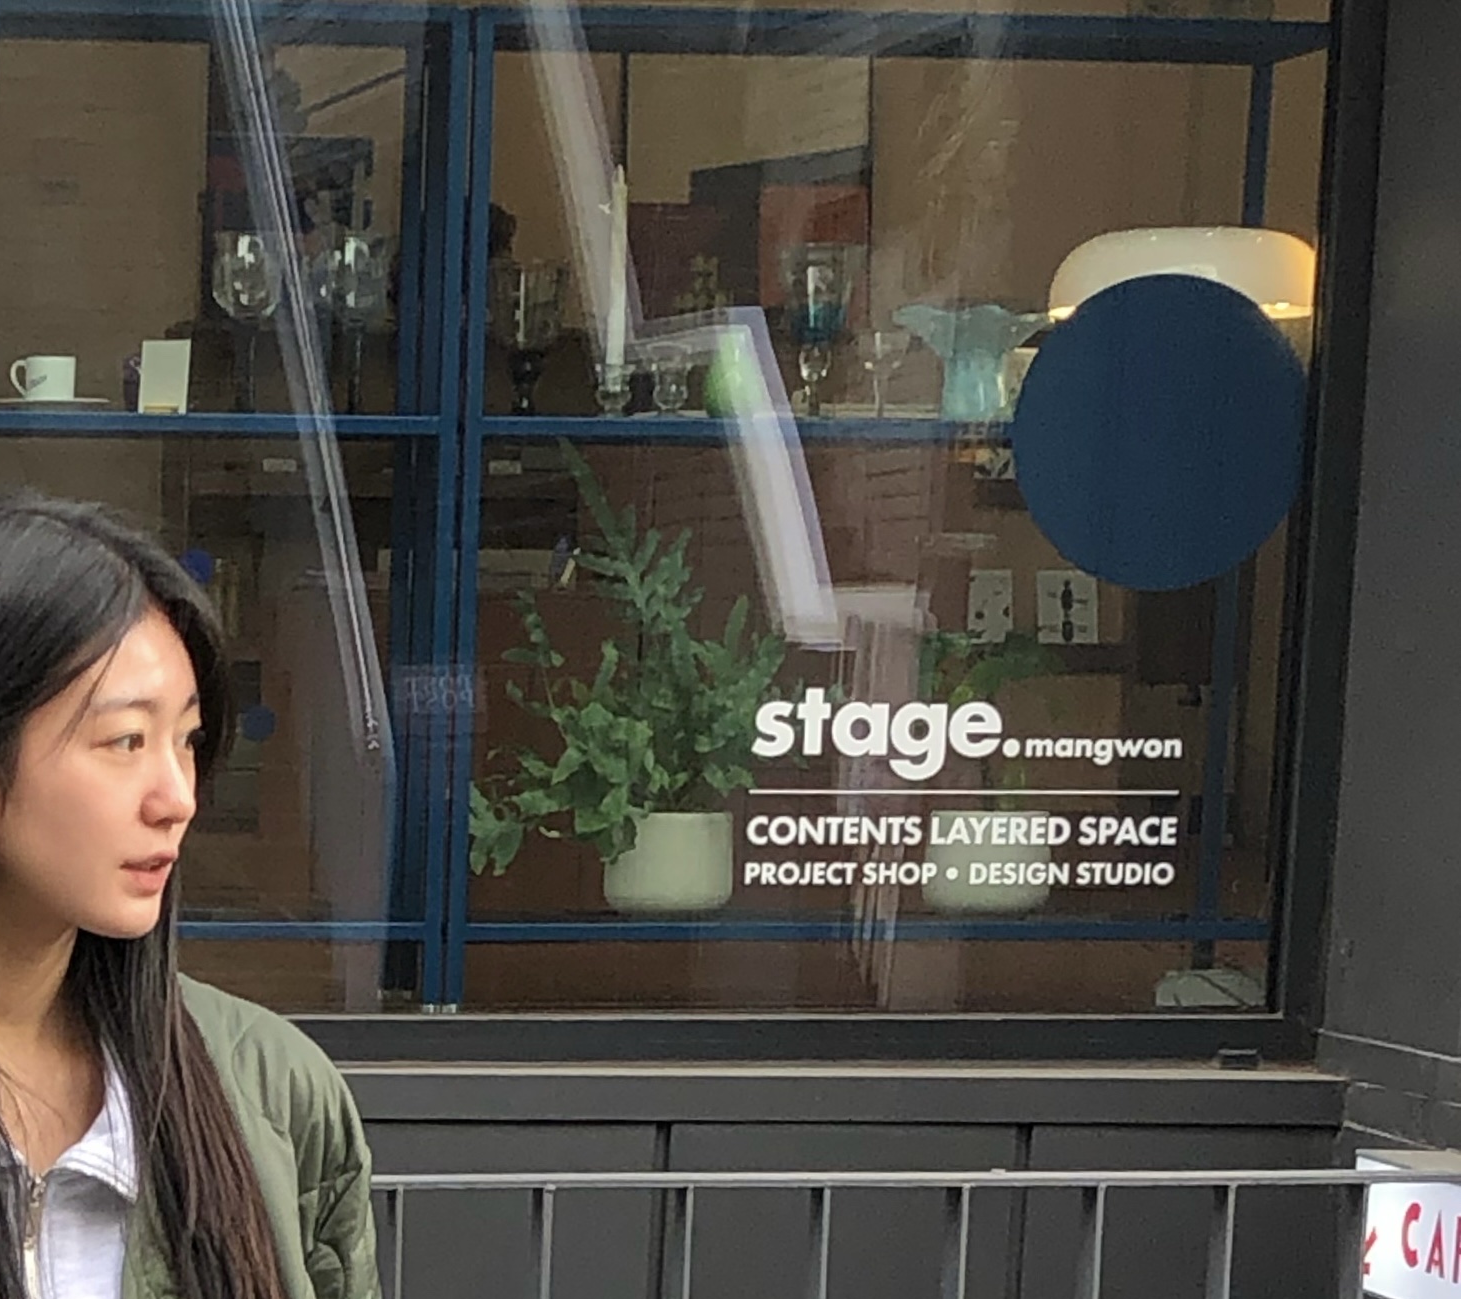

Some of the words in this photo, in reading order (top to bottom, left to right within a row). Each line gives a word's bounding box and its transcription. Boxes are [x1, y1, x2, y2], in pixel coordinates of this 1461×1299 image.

[1025, 737, 1183, 766] mangwon
[746, 816, 922, 846] CONTENTS
[930, 816, 1070, 846] LAYERED
[1078, 817, 1177, 846] SPACE
[743, 862, 856, 886] PROJECT
[862, 862, 937, 886] SHOP
[969, 863, 1070, 886] DESIGN
[1076, 863, 1175, 886] STUDIO
[1401, 1202, 1461, 1284] CA
